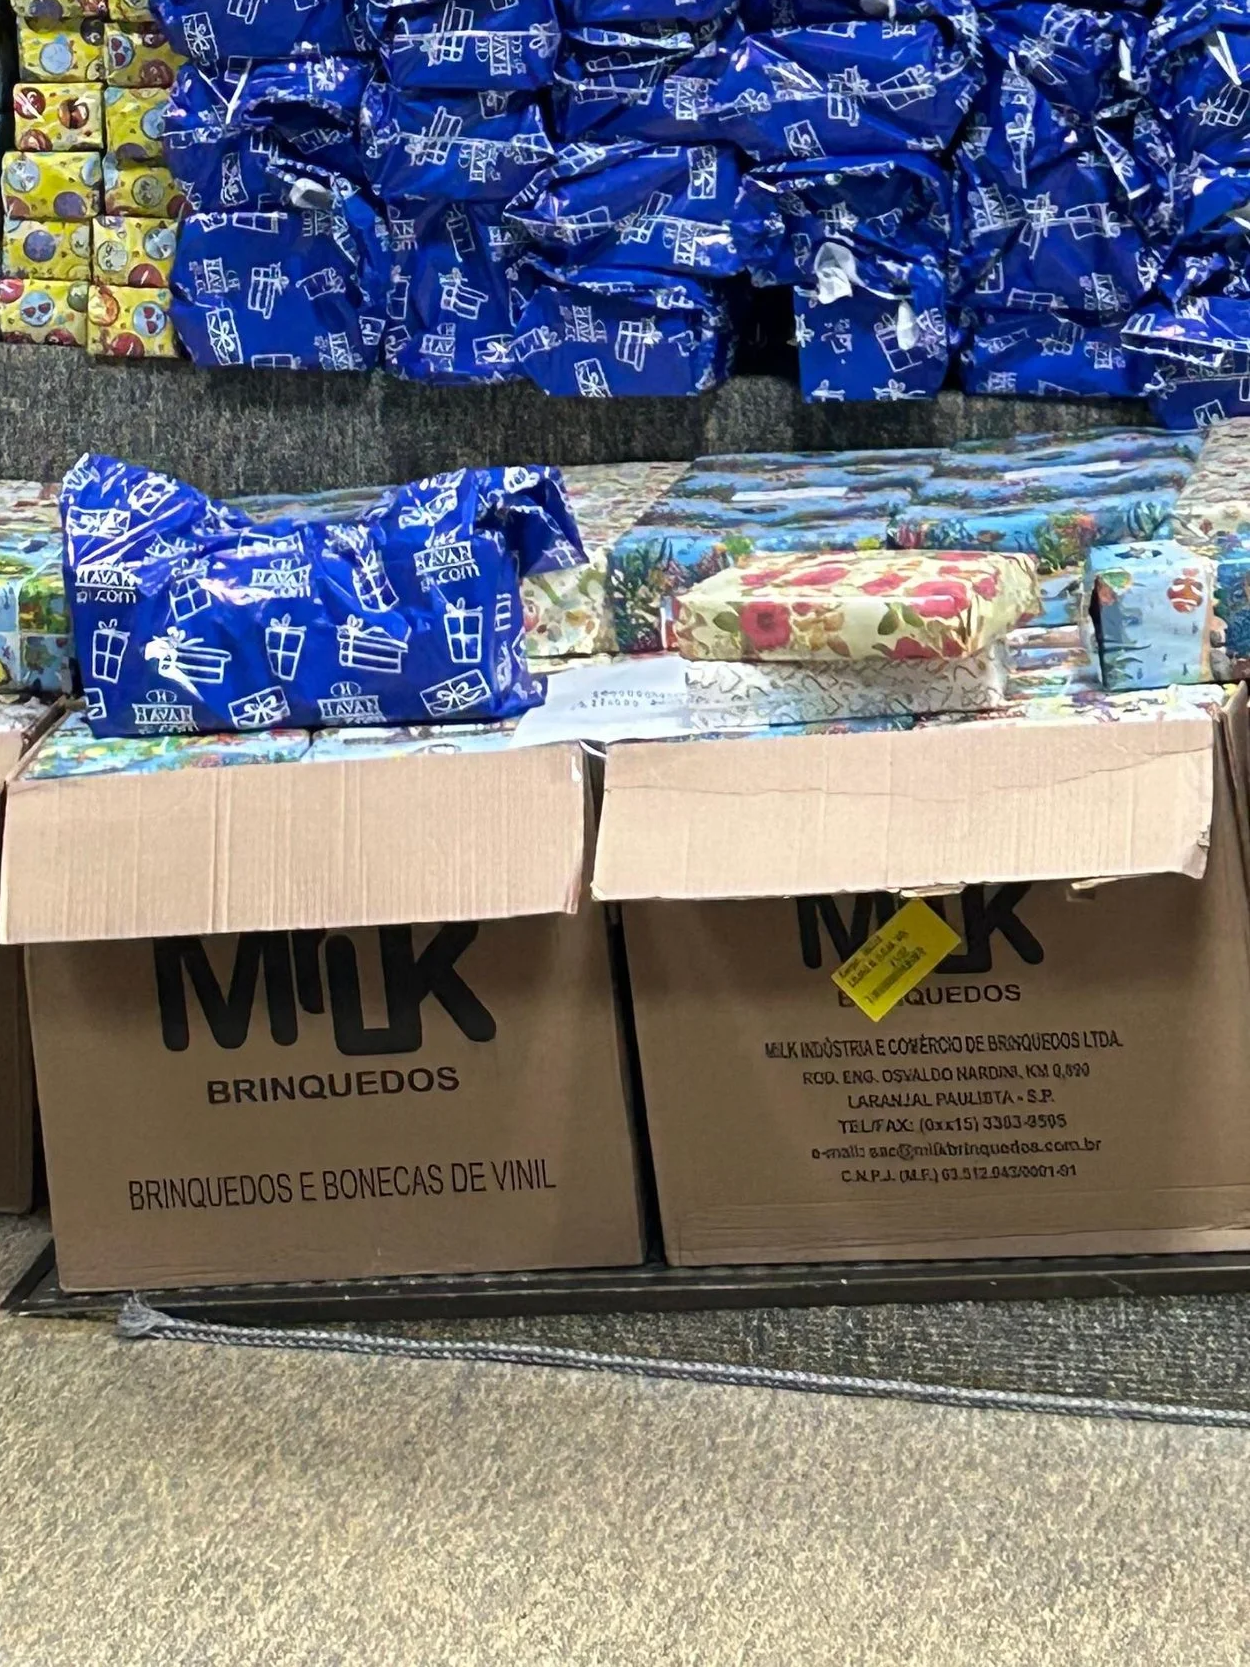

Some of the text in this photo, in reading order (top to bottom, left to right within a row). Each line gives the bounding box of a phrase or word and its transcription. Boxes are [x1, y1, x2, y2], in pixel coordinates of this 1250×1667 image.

[876, 1039, 886, 1056] E
[966, 1035, 985, 1053] DE
[207, 1065, 461, 1105] BRINQUEDOS
[128, 1158, 558, 1211] BRINQUEDOS E BONECAS DE VINIL
